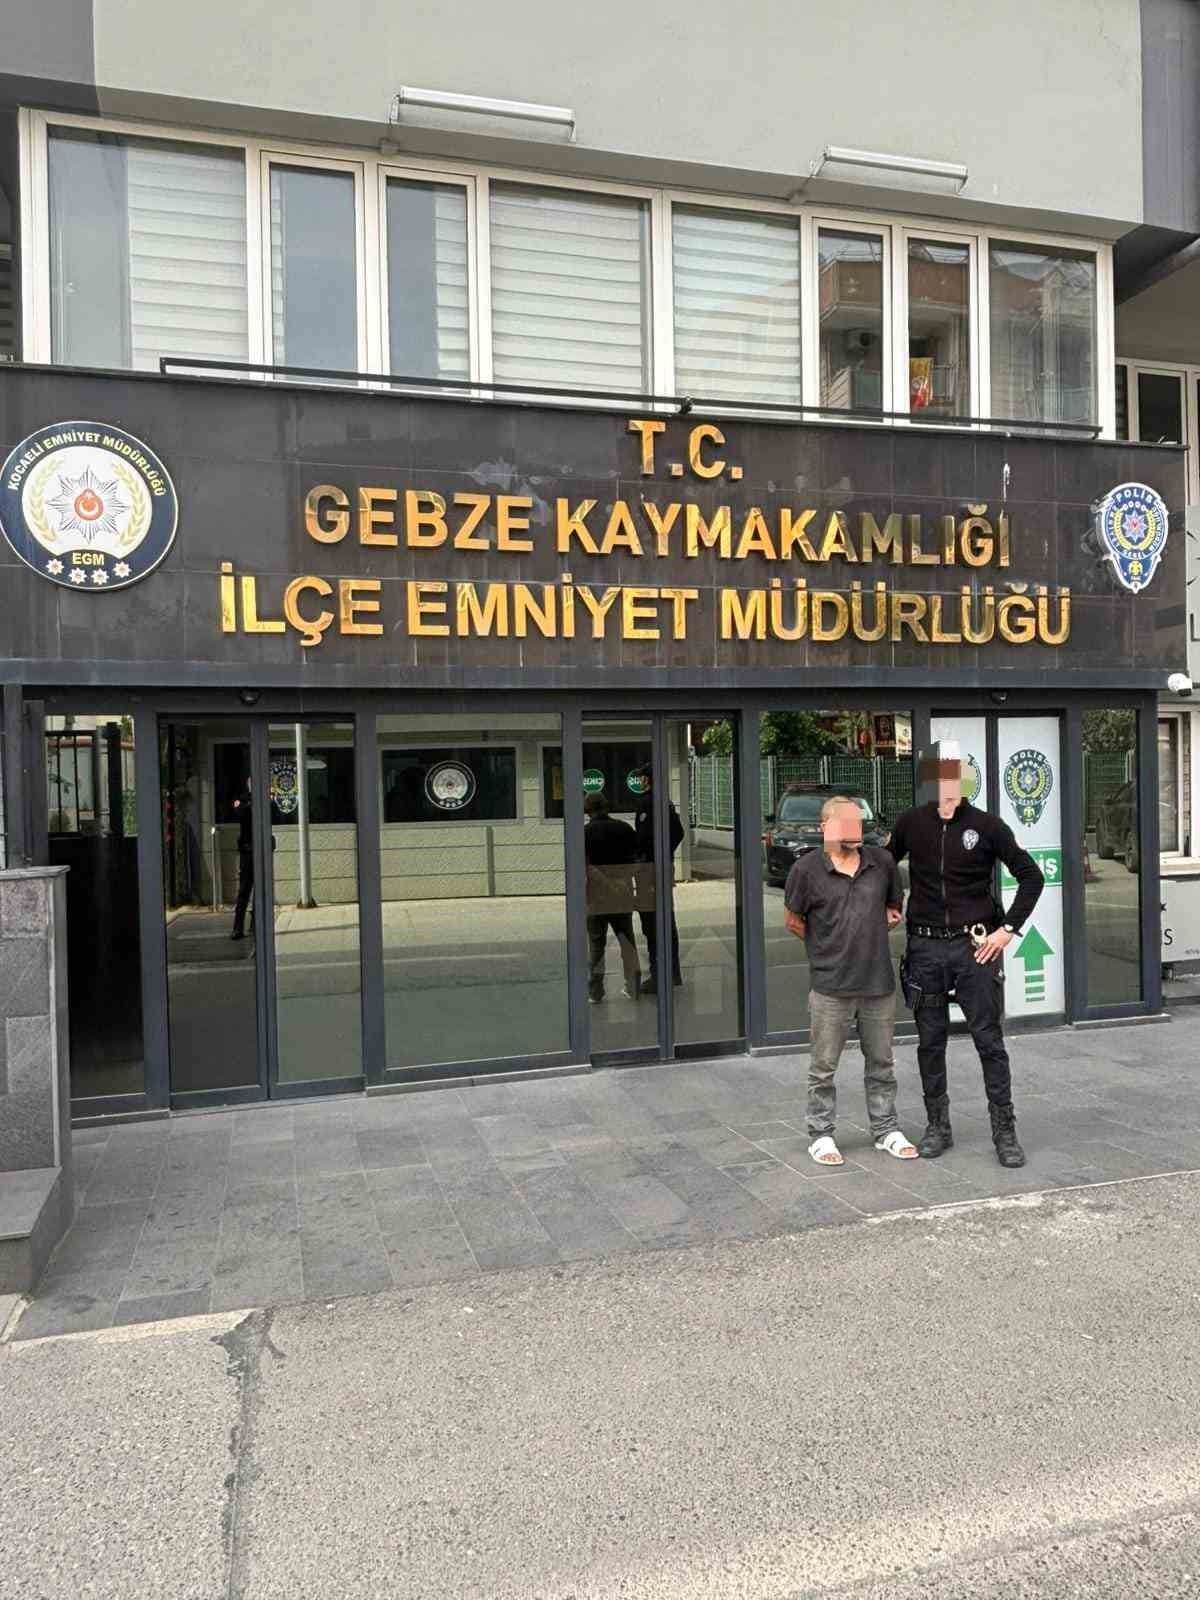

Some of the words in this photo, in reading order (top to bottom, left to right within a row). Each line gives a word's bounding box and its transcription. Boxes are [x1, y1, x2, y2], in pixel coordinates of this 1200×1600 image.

[8, 443, 45, 491] KOCAELİ
[43, 430, 101, 450] EMNİYET
[102, 435, 166, 496] MÜDÜRLÜĞÜ
[629, 420, 743, 479] T.C.
[72, 552, 105, 566] EGM
[305, 484, 534, 552] GEBZE
[556, 497, 1010, 568] KAYMAKAMLIĞI
[221, 562, 384, 647] İLÇE
[407, 573, 699, 640] EMNİYET
[721, 578, 1072, 645] MÜDÜRLÜĞÜ
